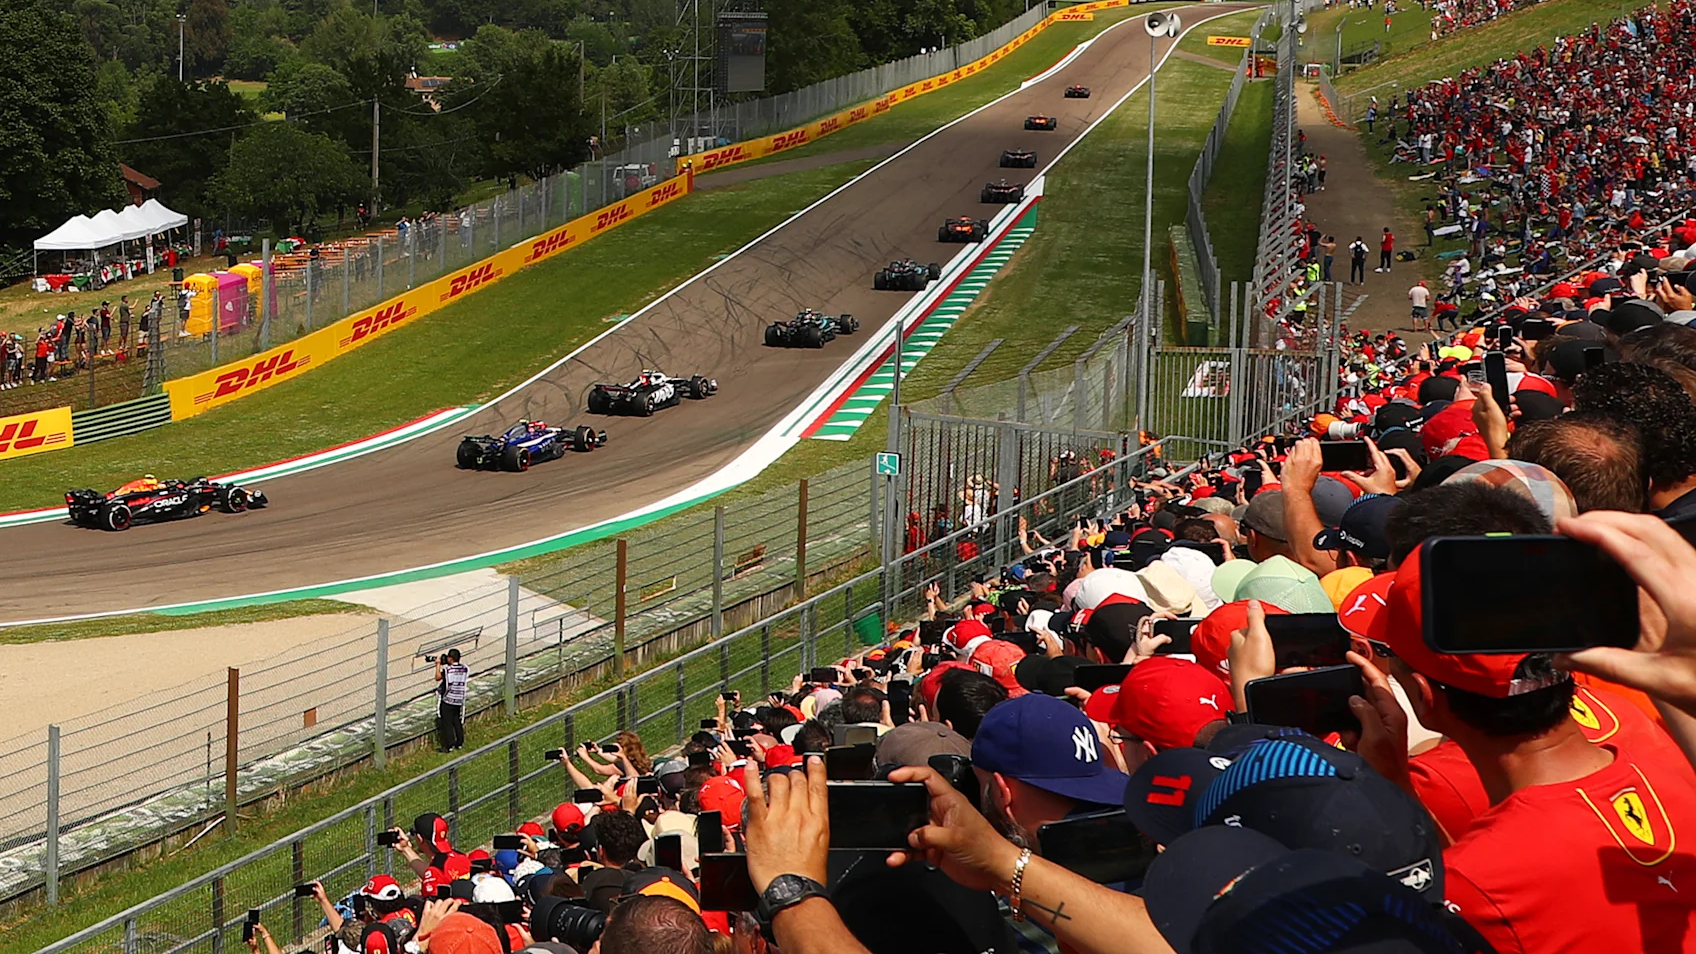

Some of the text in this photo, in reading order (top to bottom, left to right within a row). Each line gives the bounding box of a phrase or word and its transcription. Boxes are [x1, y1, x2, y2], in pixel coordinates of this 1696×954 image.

[1215, 38, 1244, 46] DHL
[772, 130, 808, 152] DHL
[703, 147, 745, 169] DHL
[651, 182, 678, 206] DHL
[597, 204, 629, 231] DHL
[532, 230, 570, 260] DHL
[448, 262, 496, 298] DHL
[350, 301, 408, 343] DHL
[214, 349, 298, 398] DHL
[153, 495, 188, 507] ORACLE
[1072, 726, 1099, 763] NY
[1146, 774, 1193, 807] 11
